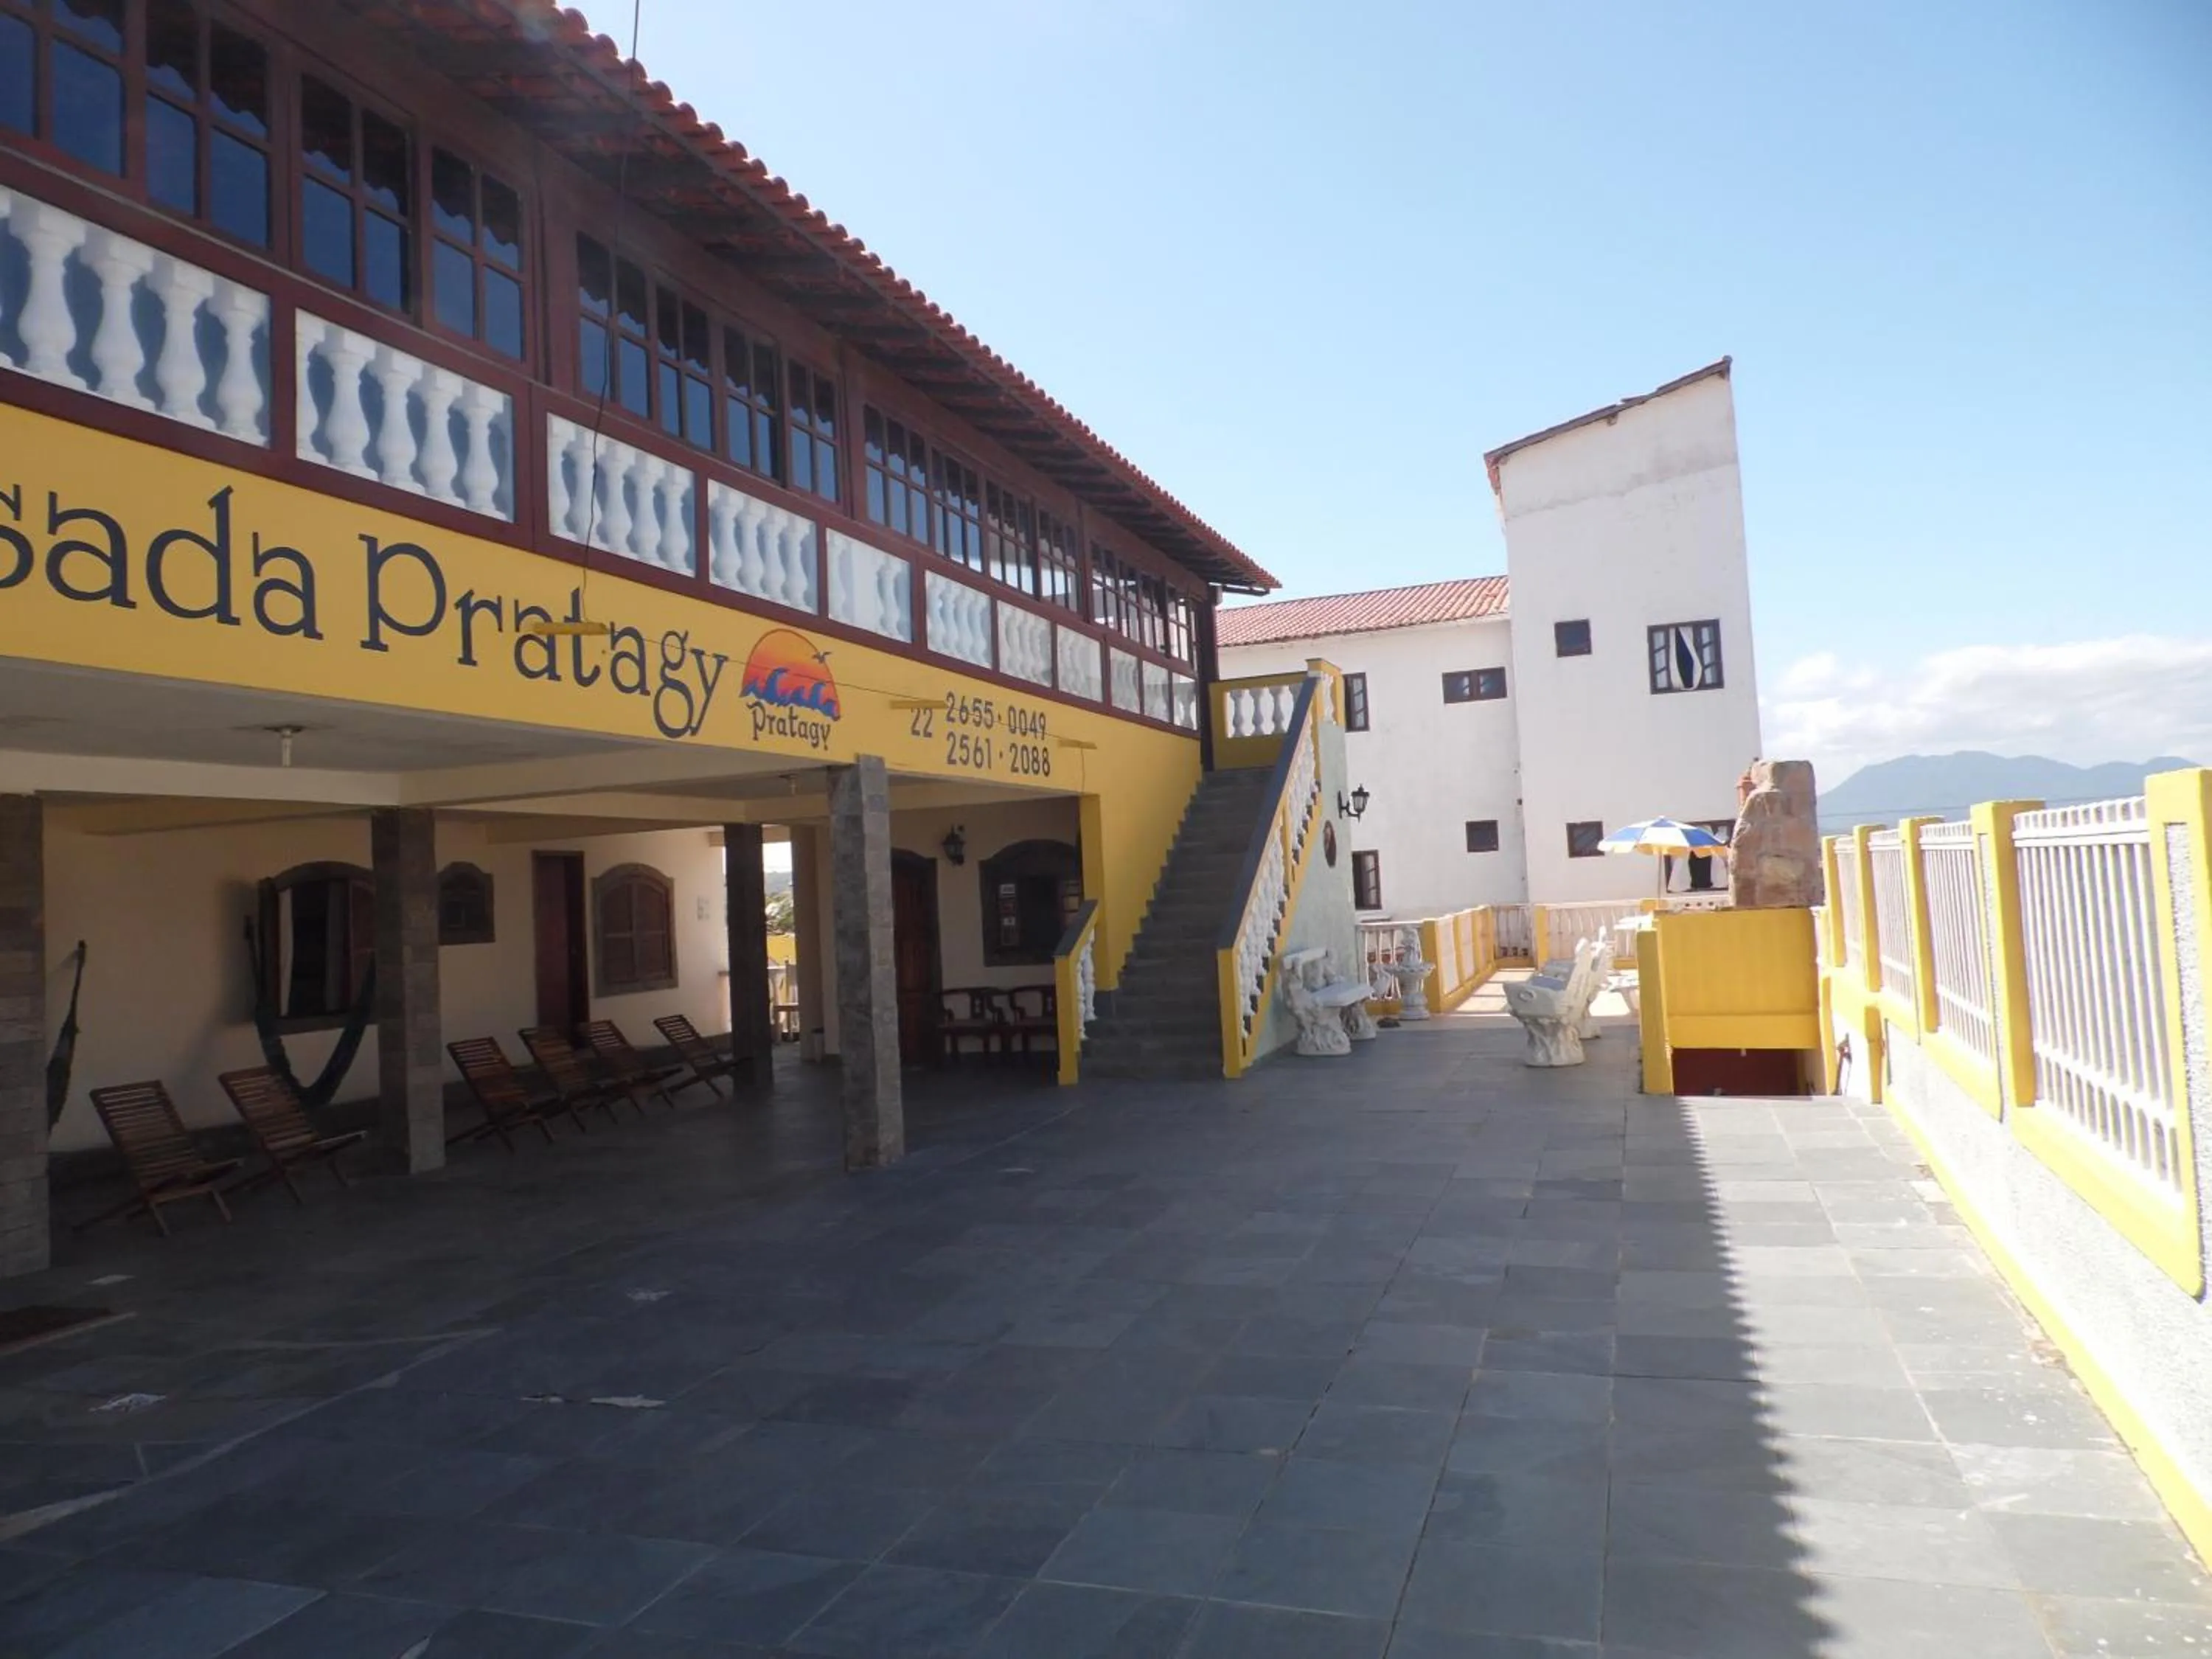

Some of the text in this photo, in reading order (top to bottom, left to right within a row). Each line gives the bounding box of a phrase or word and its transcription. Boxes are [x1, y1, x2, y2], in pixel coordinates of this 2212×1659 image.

[358, 533, 729, 739] Pratagy
[746, 701, 831, 751] Pratagy
[911, 707, 933, 738] 22
